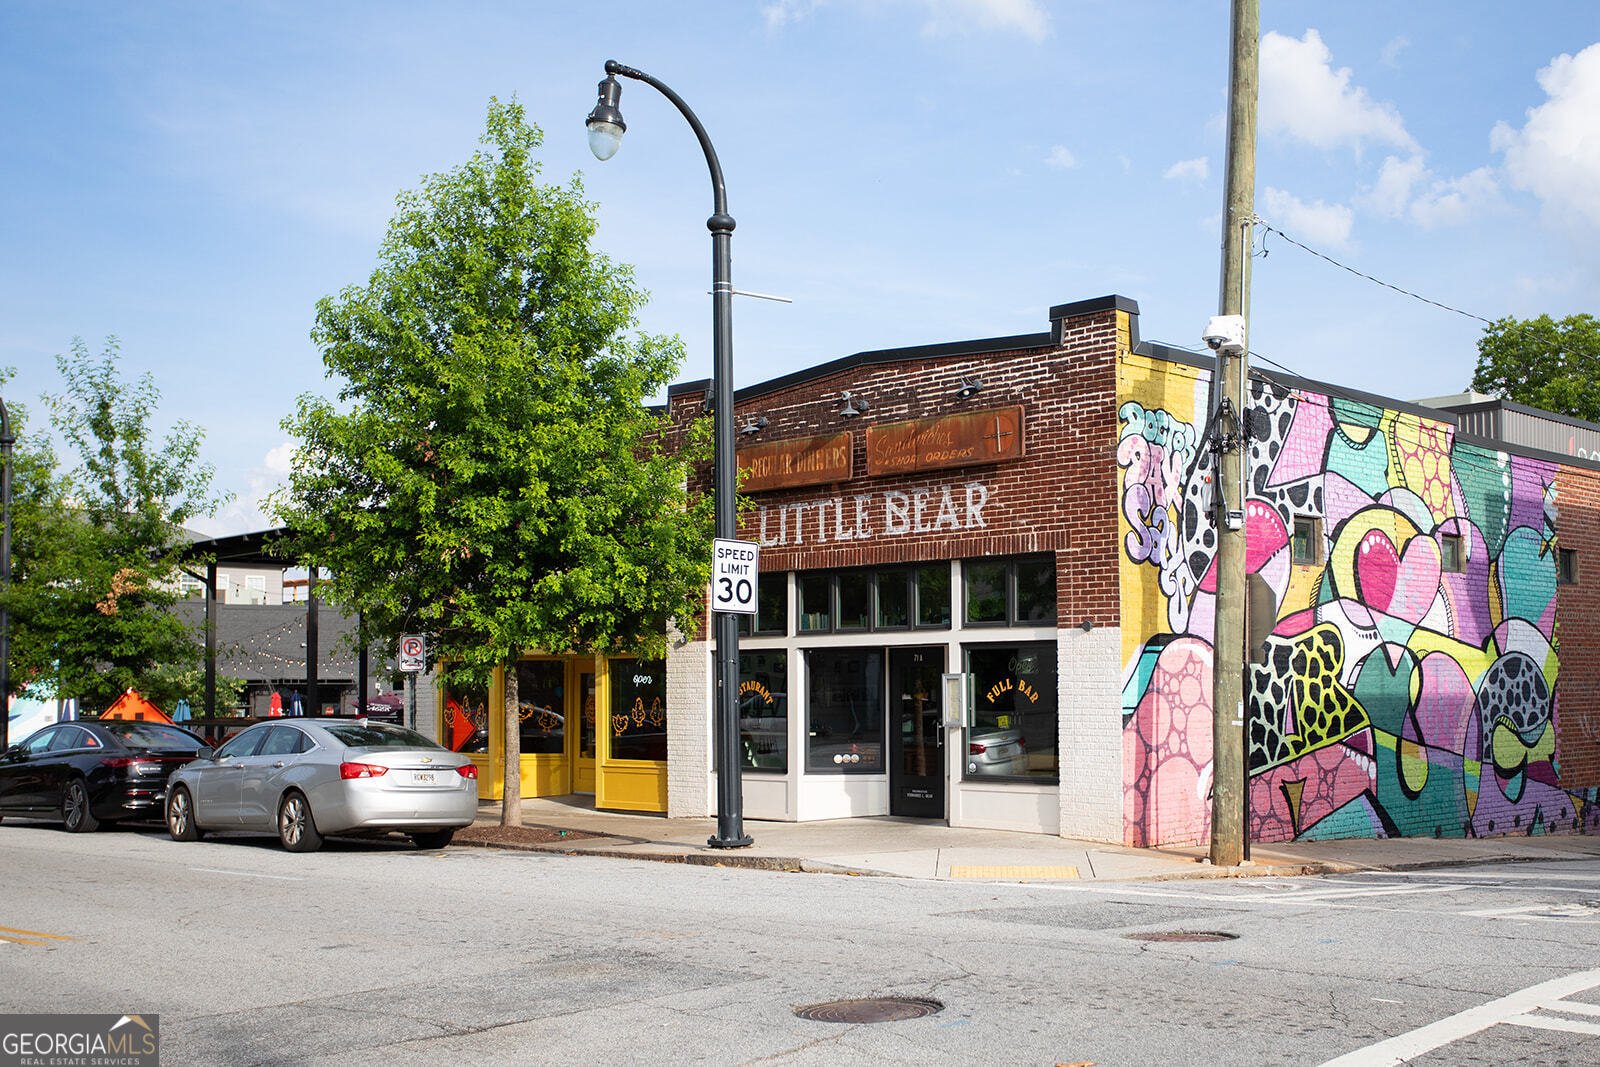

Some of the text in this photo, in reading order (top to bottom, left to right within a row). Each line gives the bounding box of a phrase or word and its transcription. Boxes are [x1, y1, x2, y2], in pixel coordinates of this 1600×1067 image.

[752, 446, 847, 479] REGULAR DINNERS
[925, 447, 975, 463] ORDERS
[759, 482, 989, 548] LITTLE BEAR
[717, 547, 755, 562] SPEED
[720, 562, 750, 576] LIMIT
[717, 577, 752, 605] 30
[986, 678, 1013, 704] FULL
[1018, 679, 1039, 704] BAR
